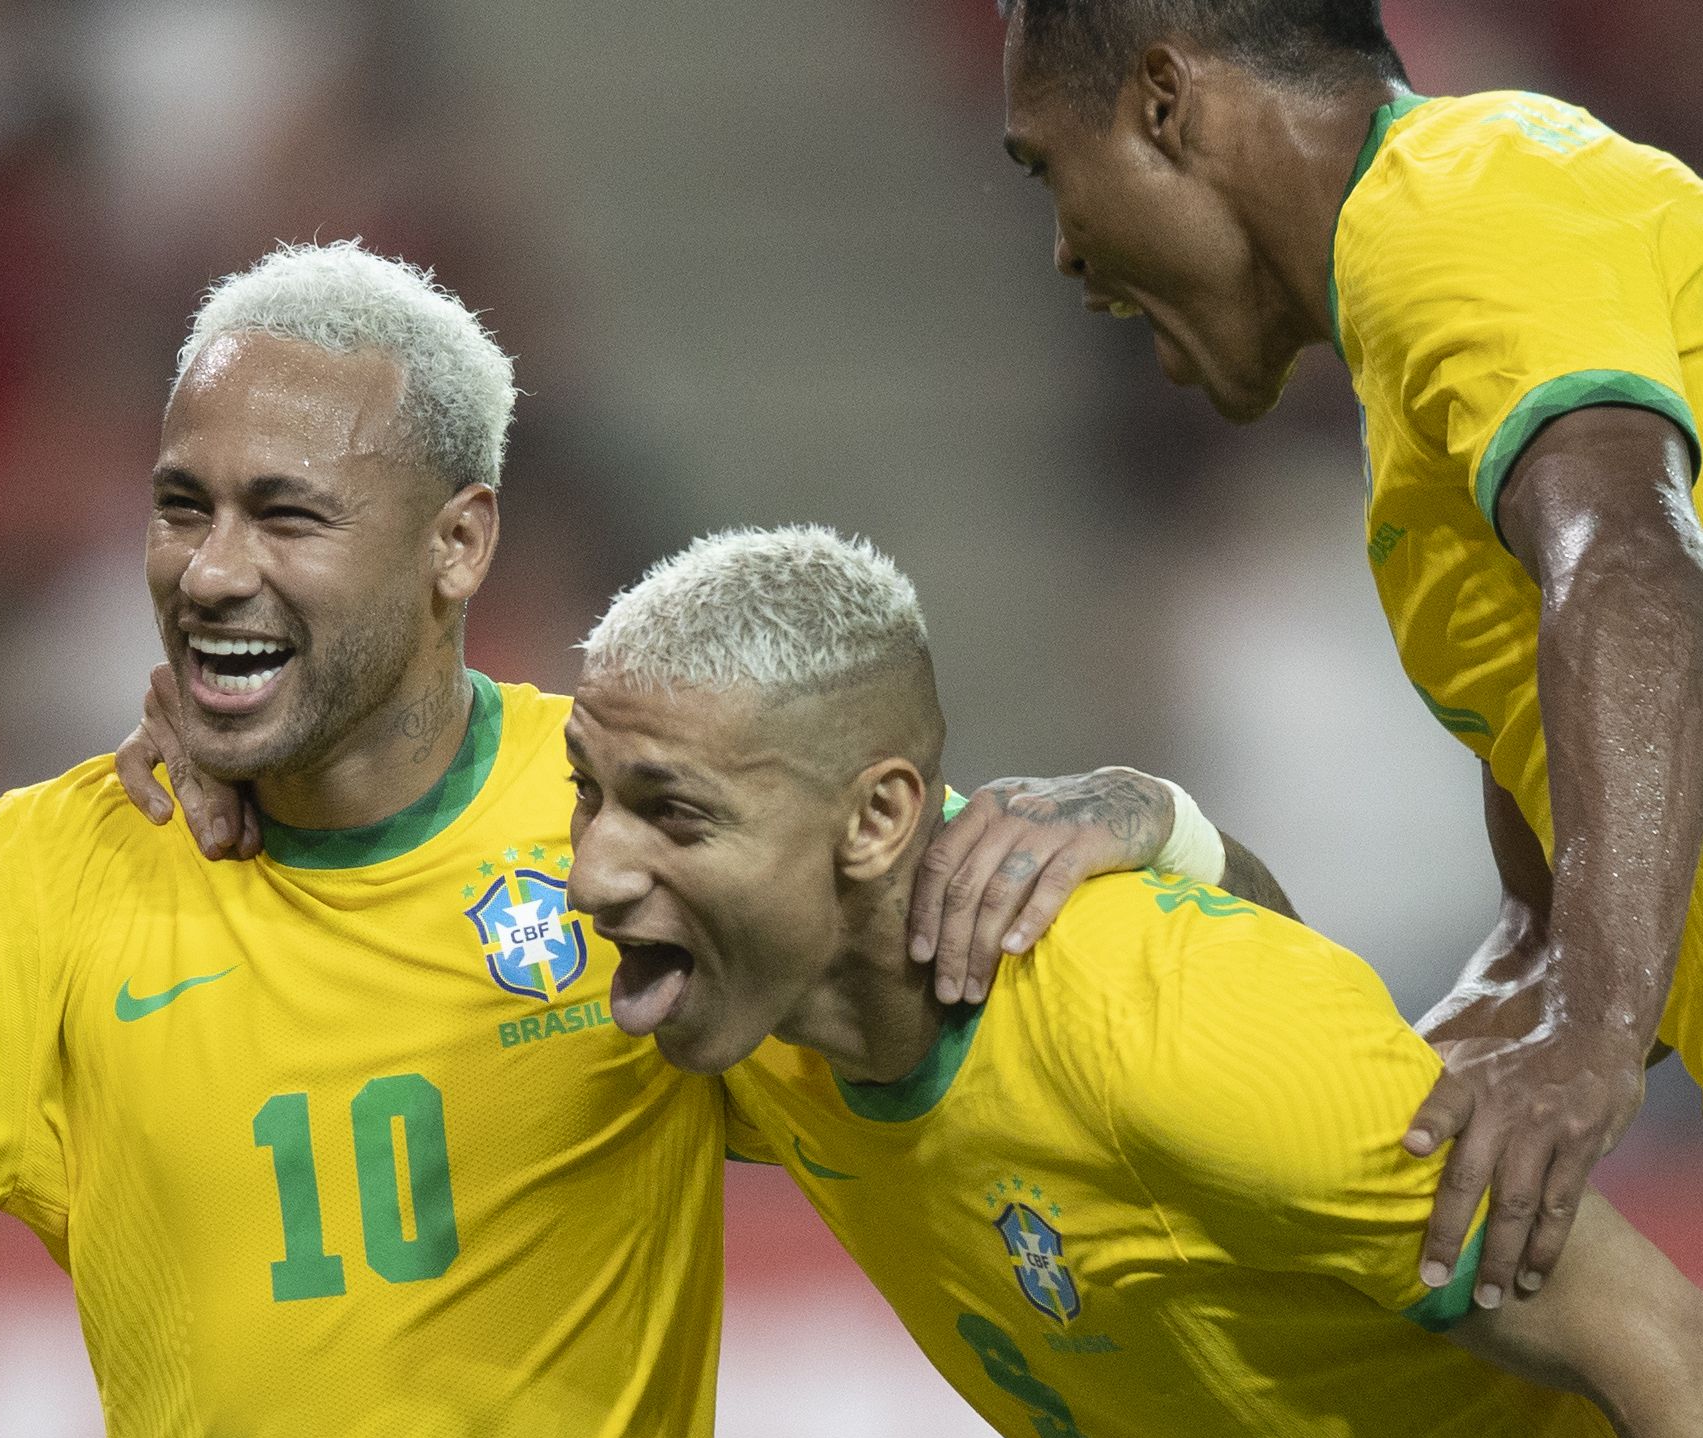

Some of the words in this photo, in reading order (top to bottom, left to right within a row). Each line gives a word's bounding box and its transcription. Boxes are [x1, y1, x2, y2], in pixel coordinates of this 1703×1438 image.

[510, 921, 550, 944] CBF
[499, 1001, 614, 1048] BRASIL
[252, 1072, 461, 1303] 10
[1026, 1252, 1051, 1268] CBF
